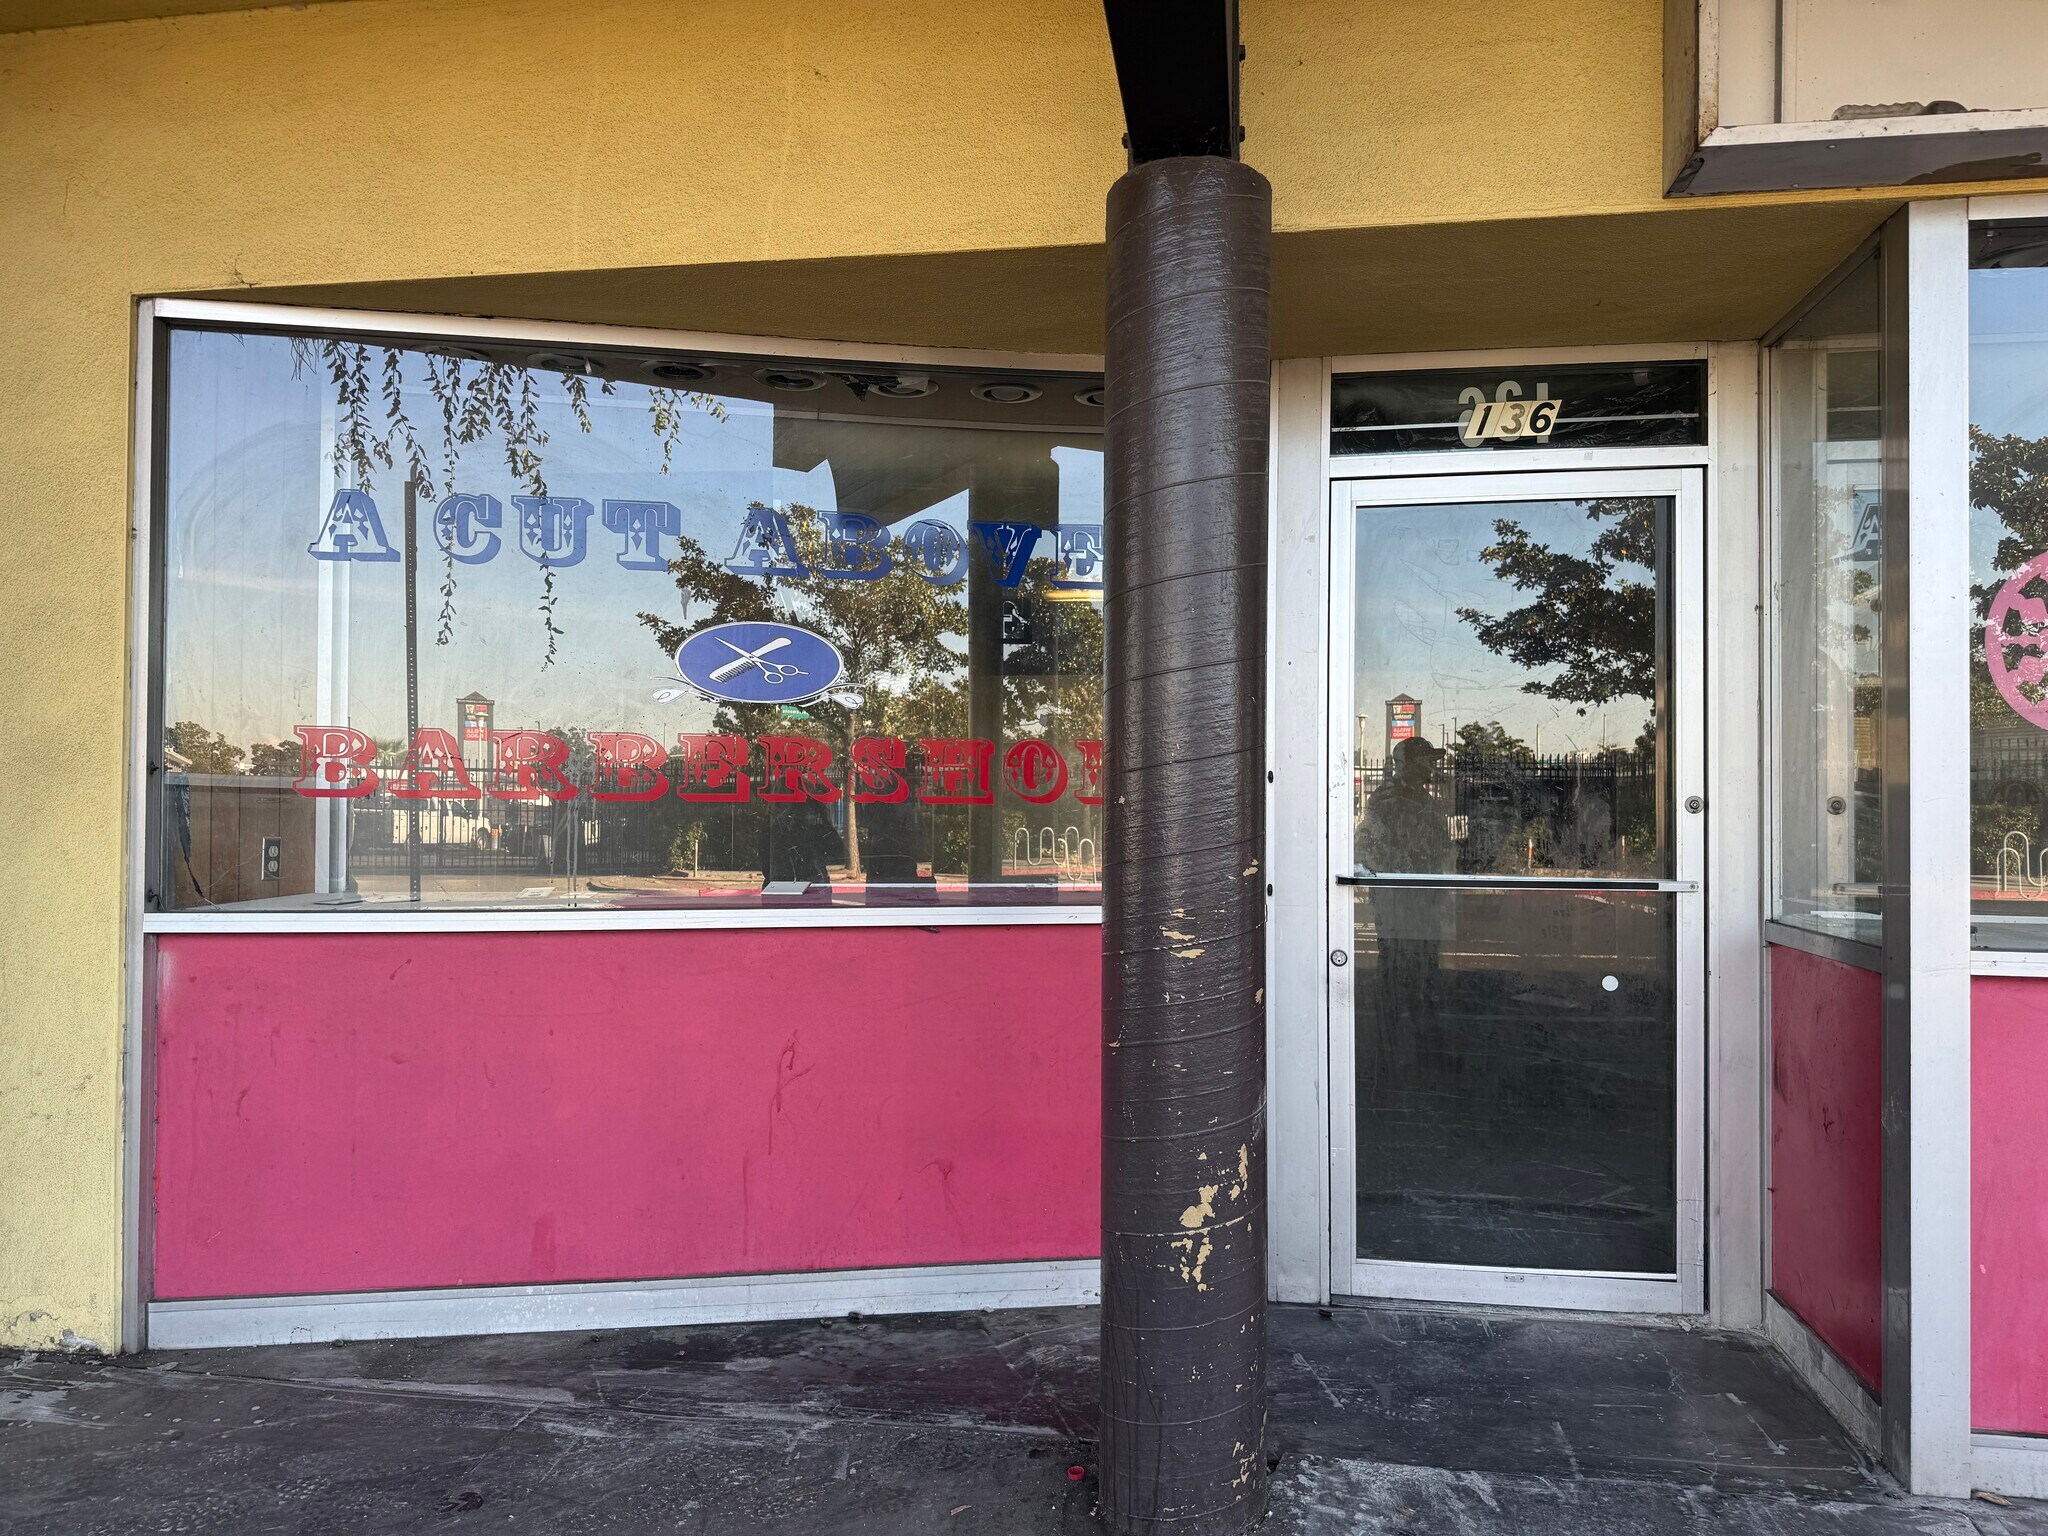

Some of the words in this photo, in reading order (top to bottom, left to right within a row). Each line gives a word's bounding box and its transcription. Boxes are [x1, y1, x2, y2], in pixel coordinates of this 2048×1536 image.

[1476, 401, 1556, 436] 136
[307, 488, 401, 562] A
[433, 493, 682, 572] CUT
[724, 507, 1103, 589] ABOVE
